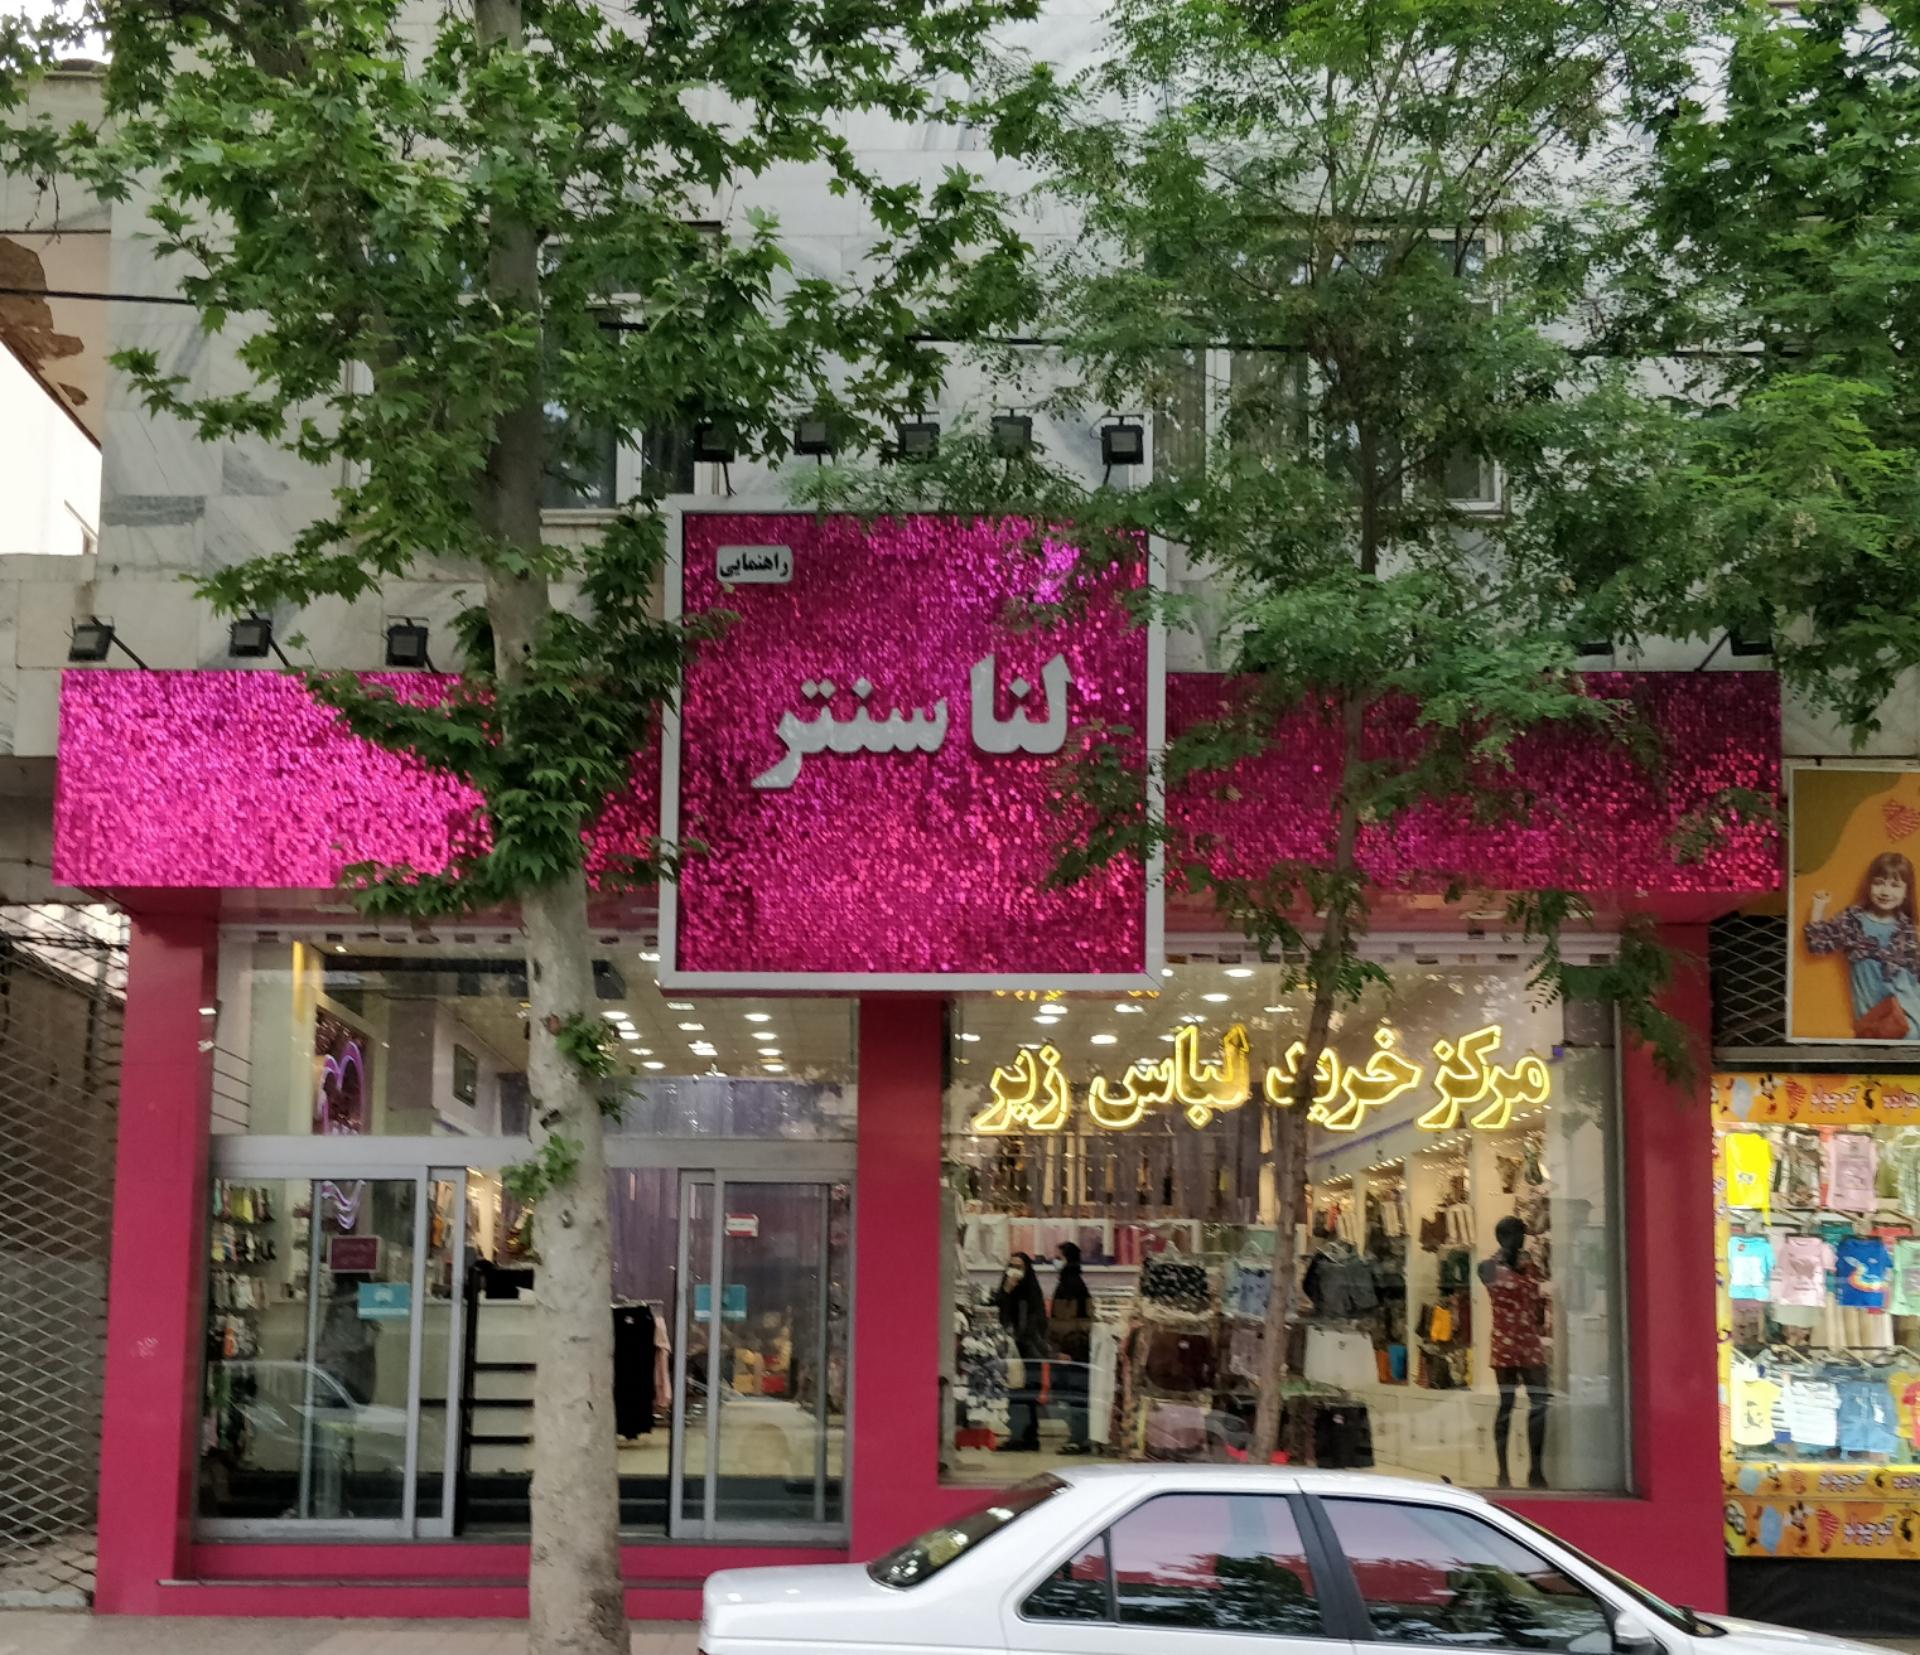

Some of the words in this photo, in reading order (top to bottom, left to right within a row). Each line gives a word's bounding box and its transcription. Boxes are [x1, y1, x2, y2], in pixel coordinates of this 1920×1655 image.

[719, 551, 790, 578] راهنمایی
[751, 677, 948, 788] سنتر
[970, 653, 1073, 754] لنا
[973, 1044, 1068, 1131] زیر
[1088, 1024, 1249, 1129] لباس
[1416, 1024, 1550, 1130] مرکز
